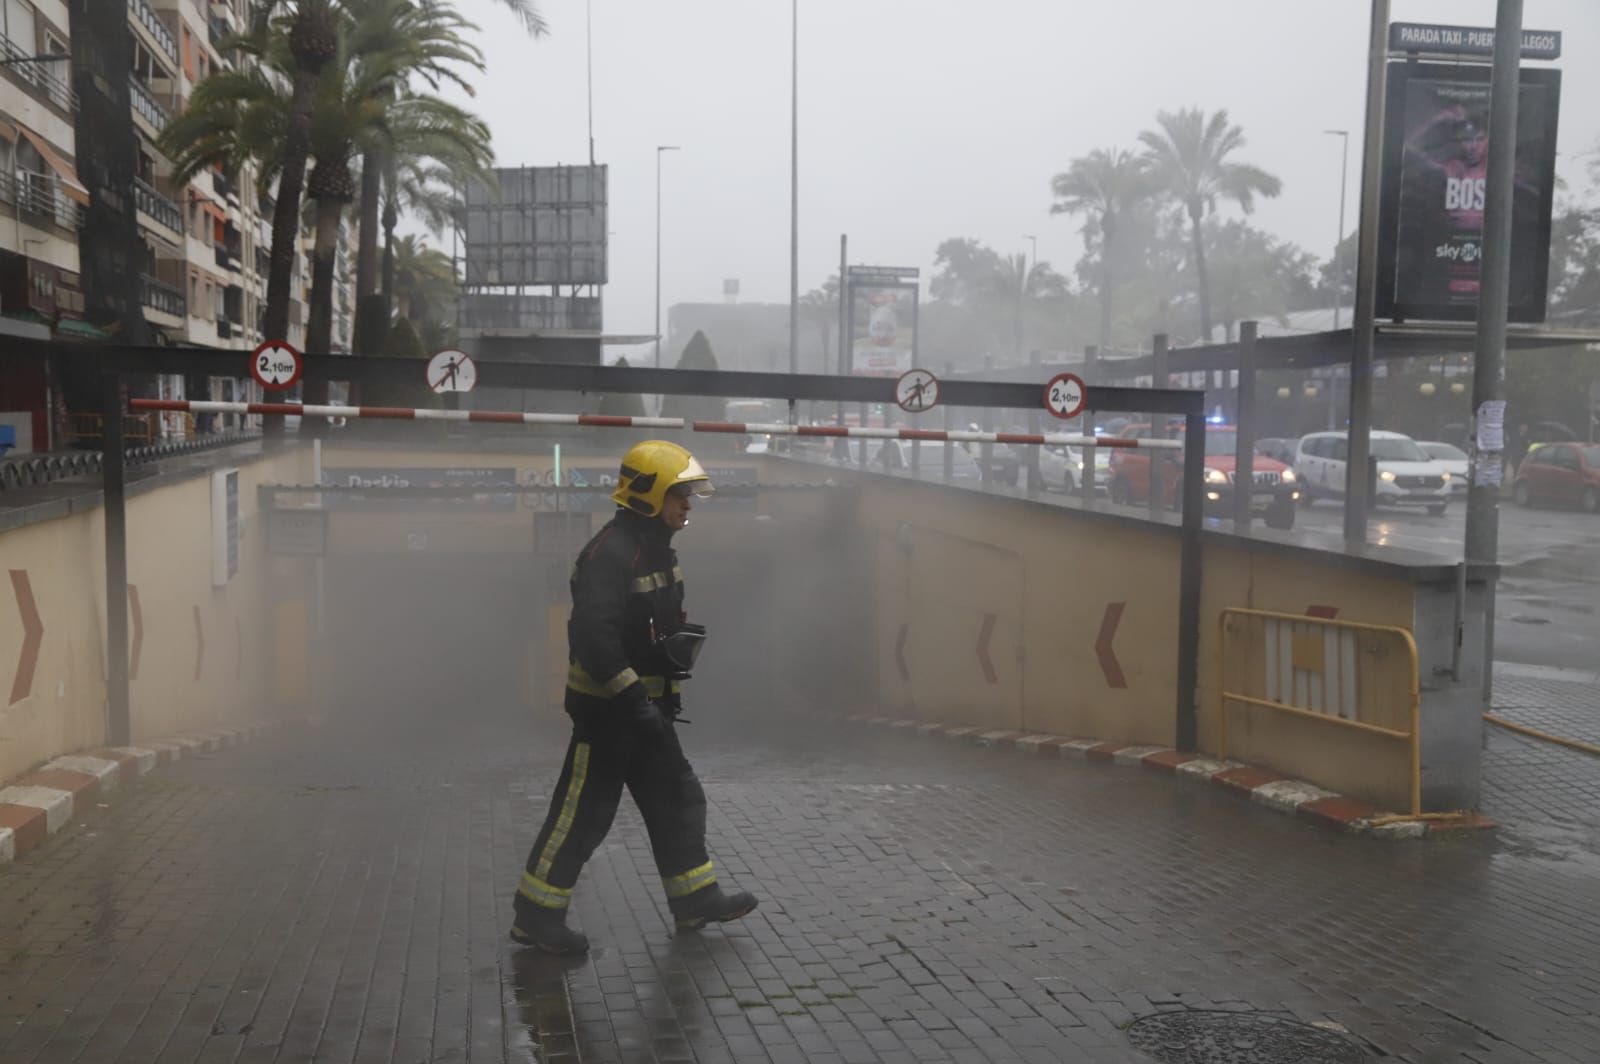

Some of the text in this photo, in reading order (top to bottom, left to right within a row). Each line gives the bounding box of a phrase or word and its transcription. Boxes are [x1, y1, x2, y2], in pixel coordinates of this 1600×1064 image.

[1401, 27, 1440, 44] PARADA
[1441, 30, 1462, 45] TAXI
[1468, 31, 1496, 47] PUER
[1445, 178, 1486, 210] BOS
